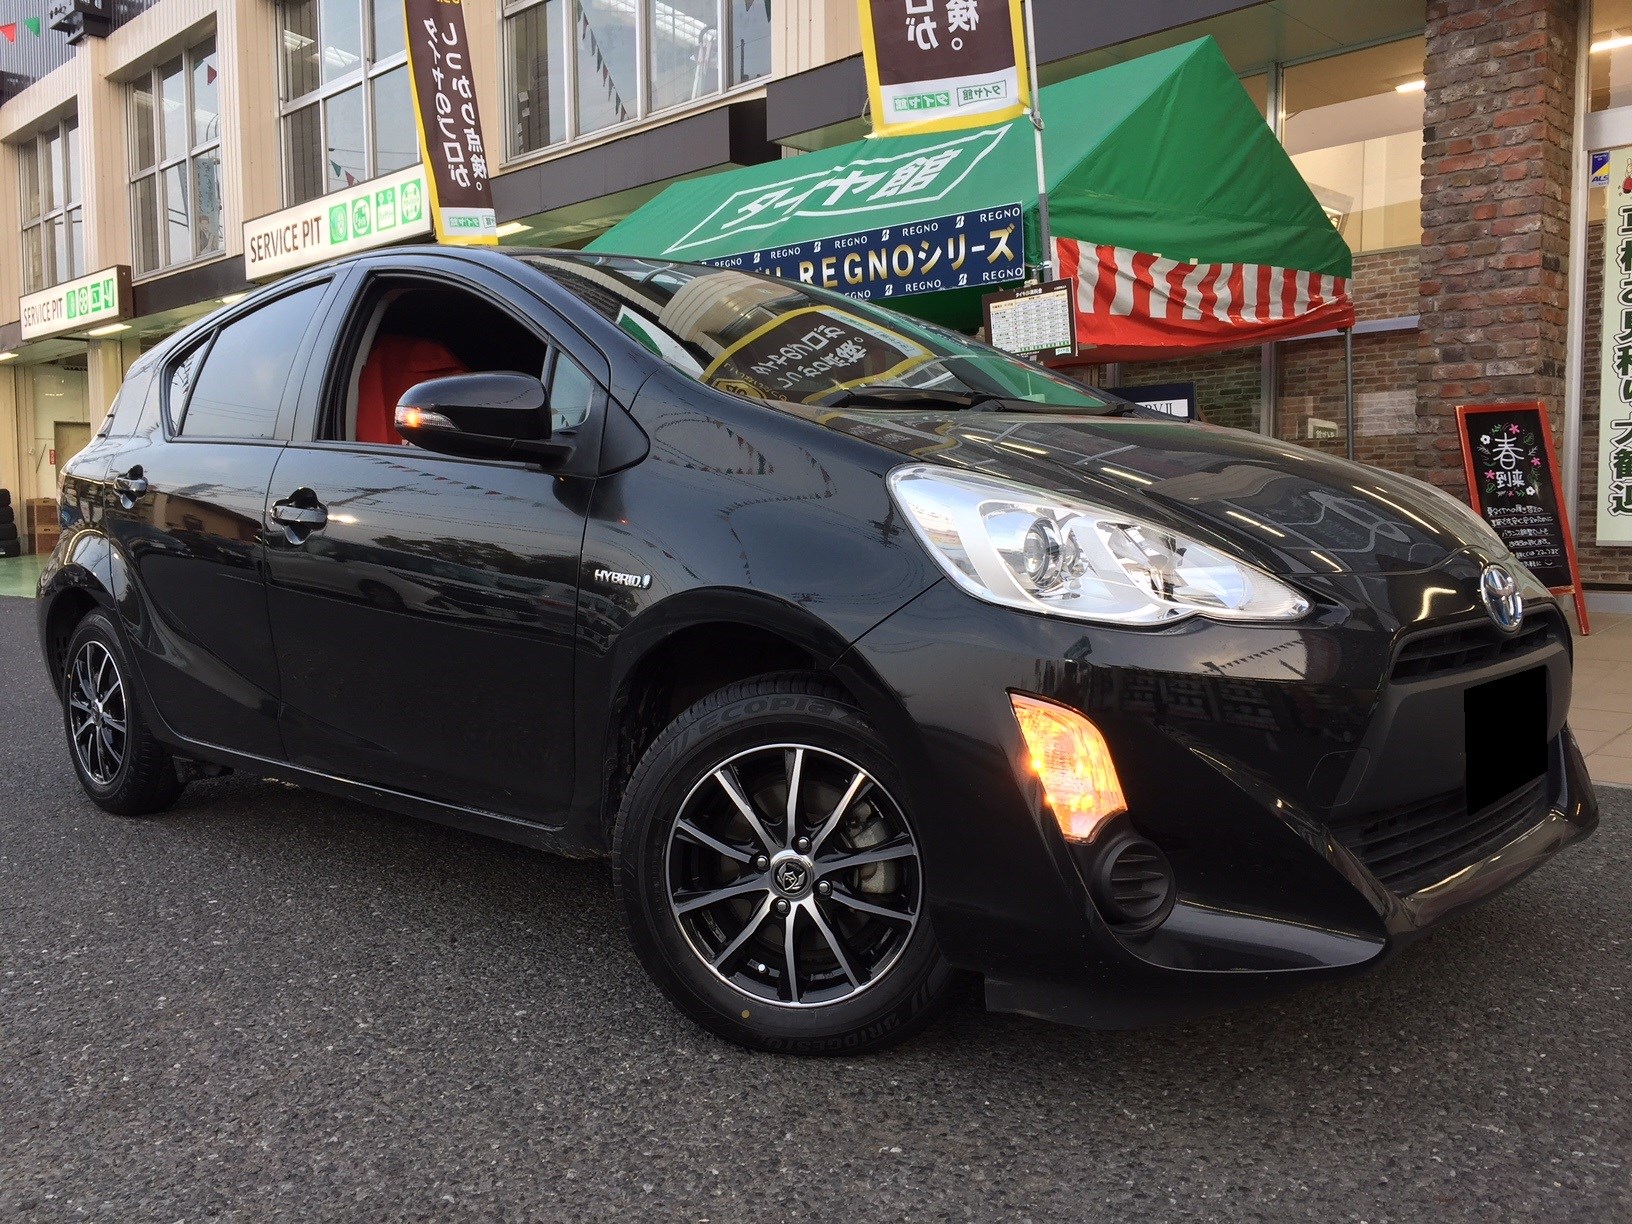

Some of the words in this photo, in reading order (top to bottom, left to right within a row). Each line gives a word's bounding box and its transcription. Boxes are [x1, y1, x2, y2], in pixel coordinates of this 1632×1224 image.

[720, 148, 964, 230] タイヤ館
[980, 207, 1021, 223] REGNO
[902, 222, 939, 237] REGNO
[250, 221, 299, 264] SERVICE
[302, 215, 322, 248] PIT
[834, 236, 868, 250] REGNO
[770, 247, 801, 260] REGNO
[982, 267, 1023, 282] REGNO
[905, 279, 942, 293] REGNO
[23, 301, 51, 328] SERVICE
[51, 297, 63, 320] PIT
[1493, 432, 1524, 470] 春
[1496, 469, 1526, 489] 到来
